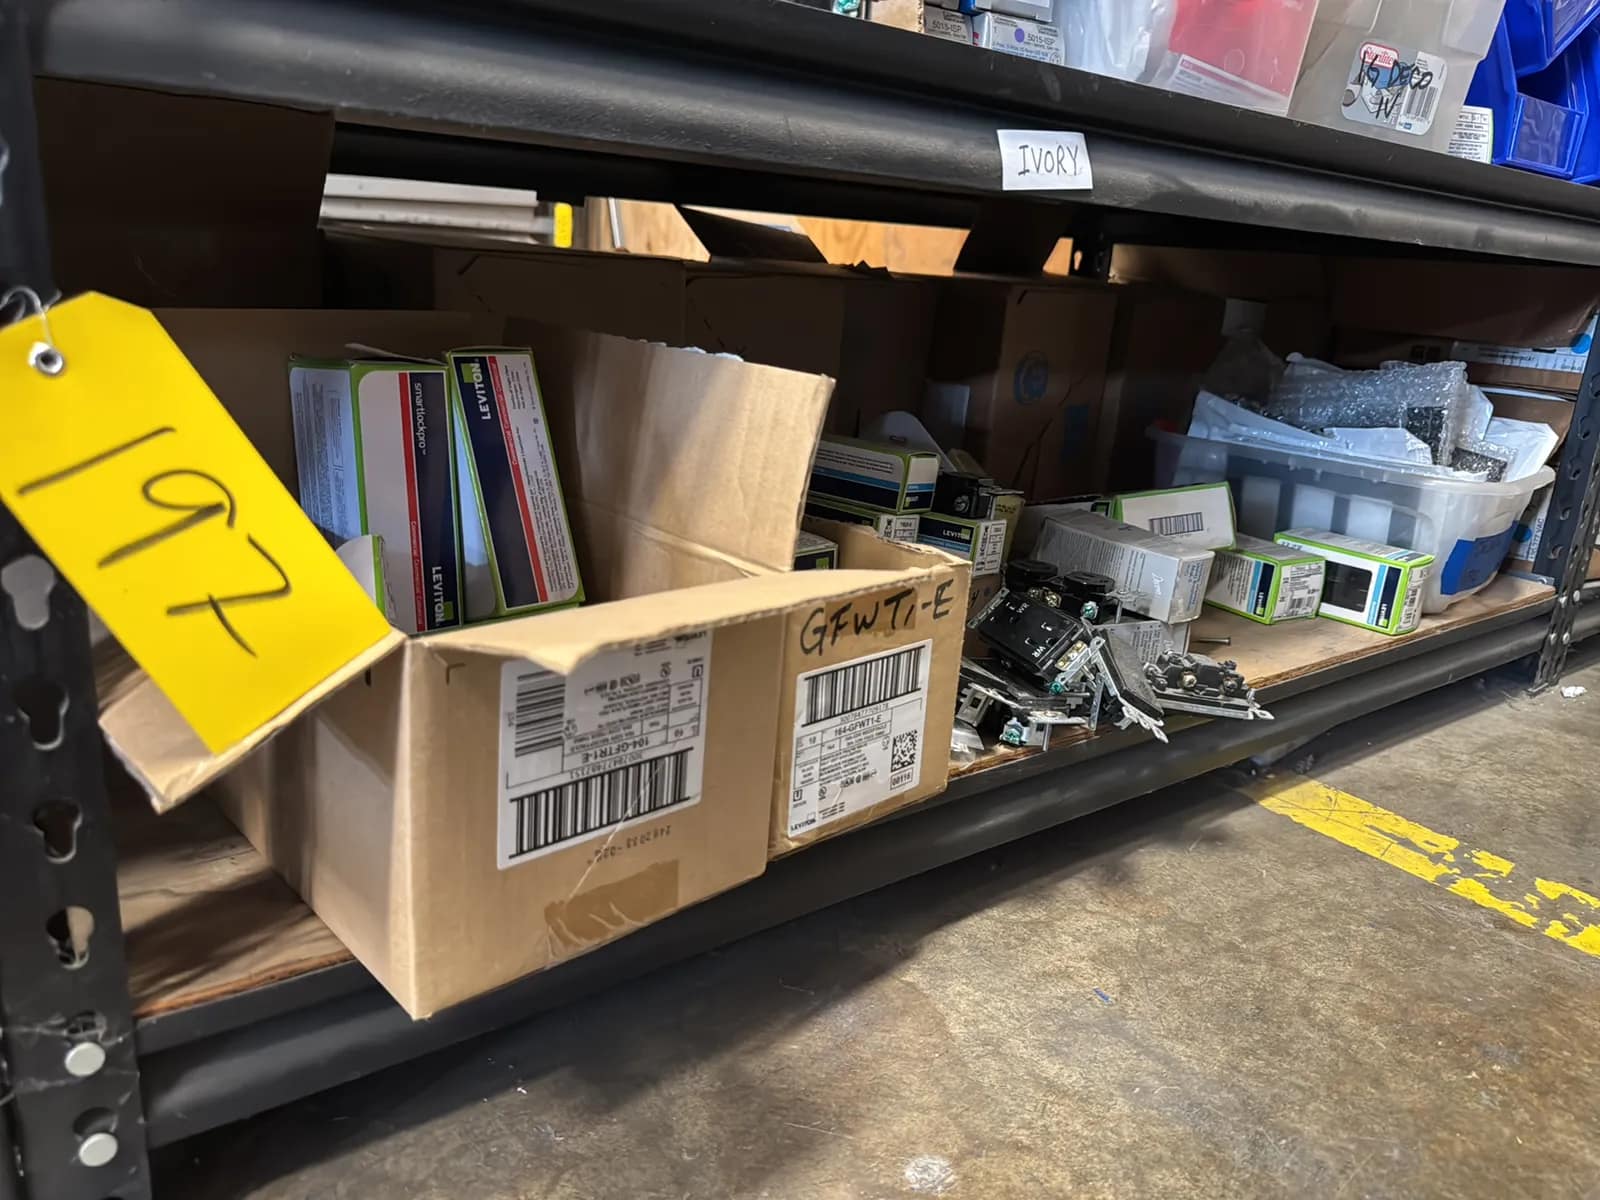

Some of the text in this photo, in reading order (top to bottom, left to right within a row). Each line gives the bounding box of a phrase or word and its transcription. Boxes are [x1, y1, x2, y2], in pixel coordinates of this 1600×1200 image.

[1018, 144, 1079, 177] IVORY
[472, 363, 492, 420] LEVITON
[16, 426, 292, 659] 197
[431, 566, 445, 622] LEVITON
[581, 736, 650, 764] 104-GFTR1-E
